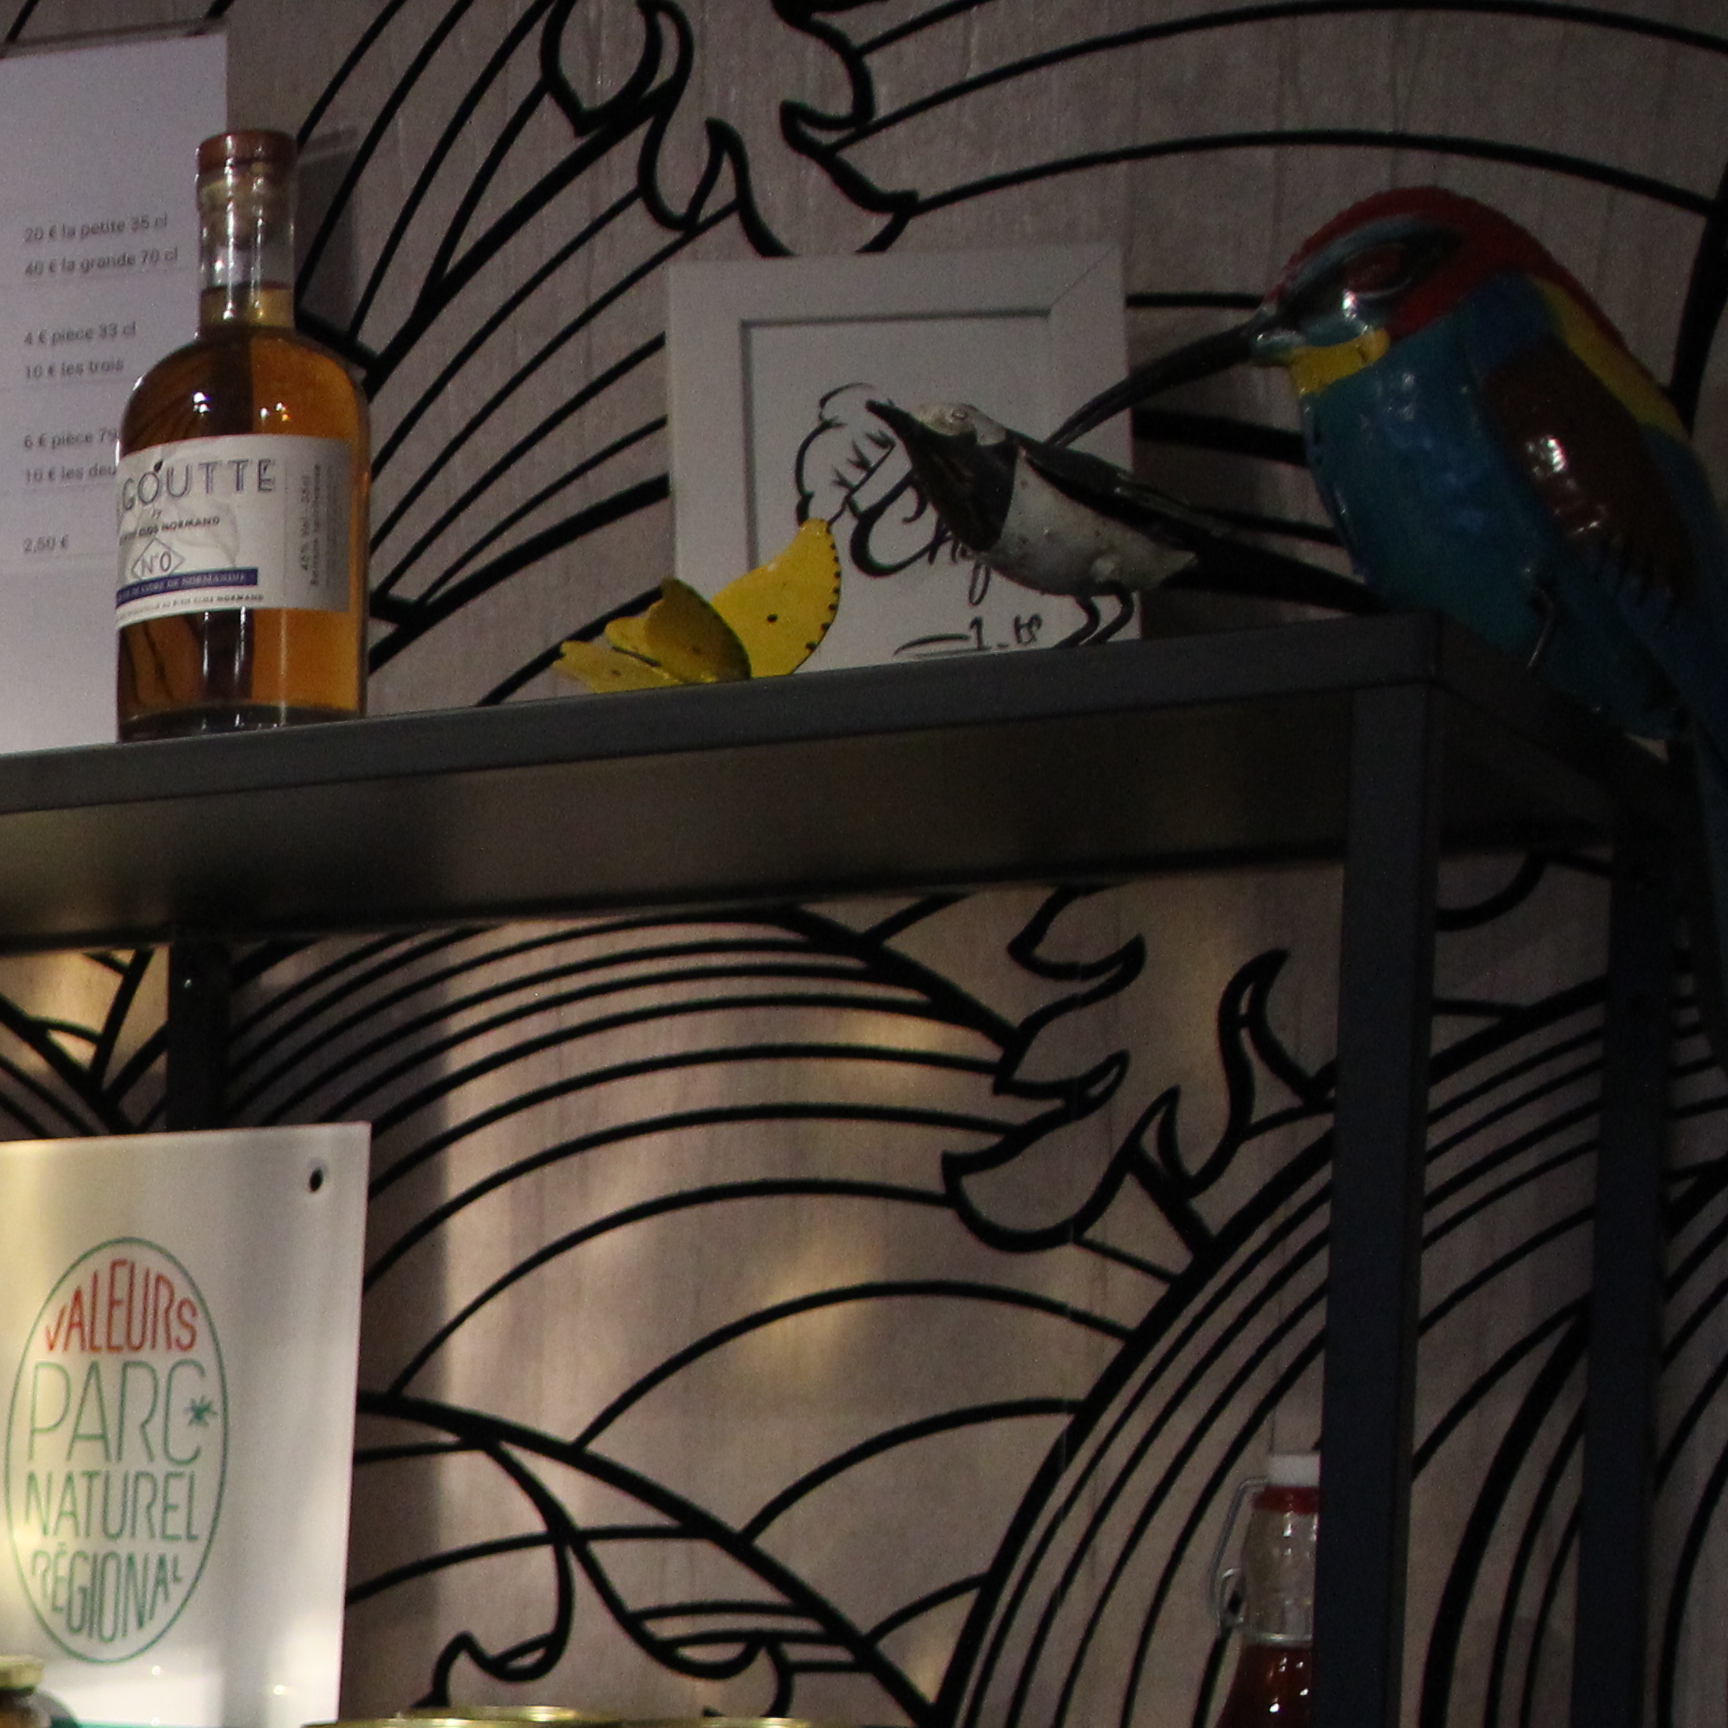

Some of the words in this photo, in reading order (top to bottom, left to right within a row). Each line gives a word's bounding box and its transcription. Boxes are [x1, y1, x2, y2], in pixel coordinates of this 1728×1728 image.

[25, 225, 44, 242] 20
[62, 223, 76, 238] la
[81, 218, 126, 239] petite
[155, 213, 168, 228] cl
[25, 262, 44, 277] 40
[62, 256, 76, 272] la
[81, 252, 136, 274] grande
[165, 246, 179, 262] cl
[24, 331, 33, 345] 4
[123, 320, 137, 336] cl
[26, 364, 44, 380] 10
[61, 360, 84, 376] les
[89, 358, 125, 373] trois
[26, 468, 44, 483] 10
[61, 464, 84, 479] les
[122, 458, 276, 511] GOUTTE
[162, 516, 221, 532] NORMAND
[44, 1257, 200, 1354] VALEURS
[28, 1359, 208, 1466] PARC
[24, 1470, 201, 1544] NATUREL
[30, 1541, 184, 1646] RÉGIONAL
